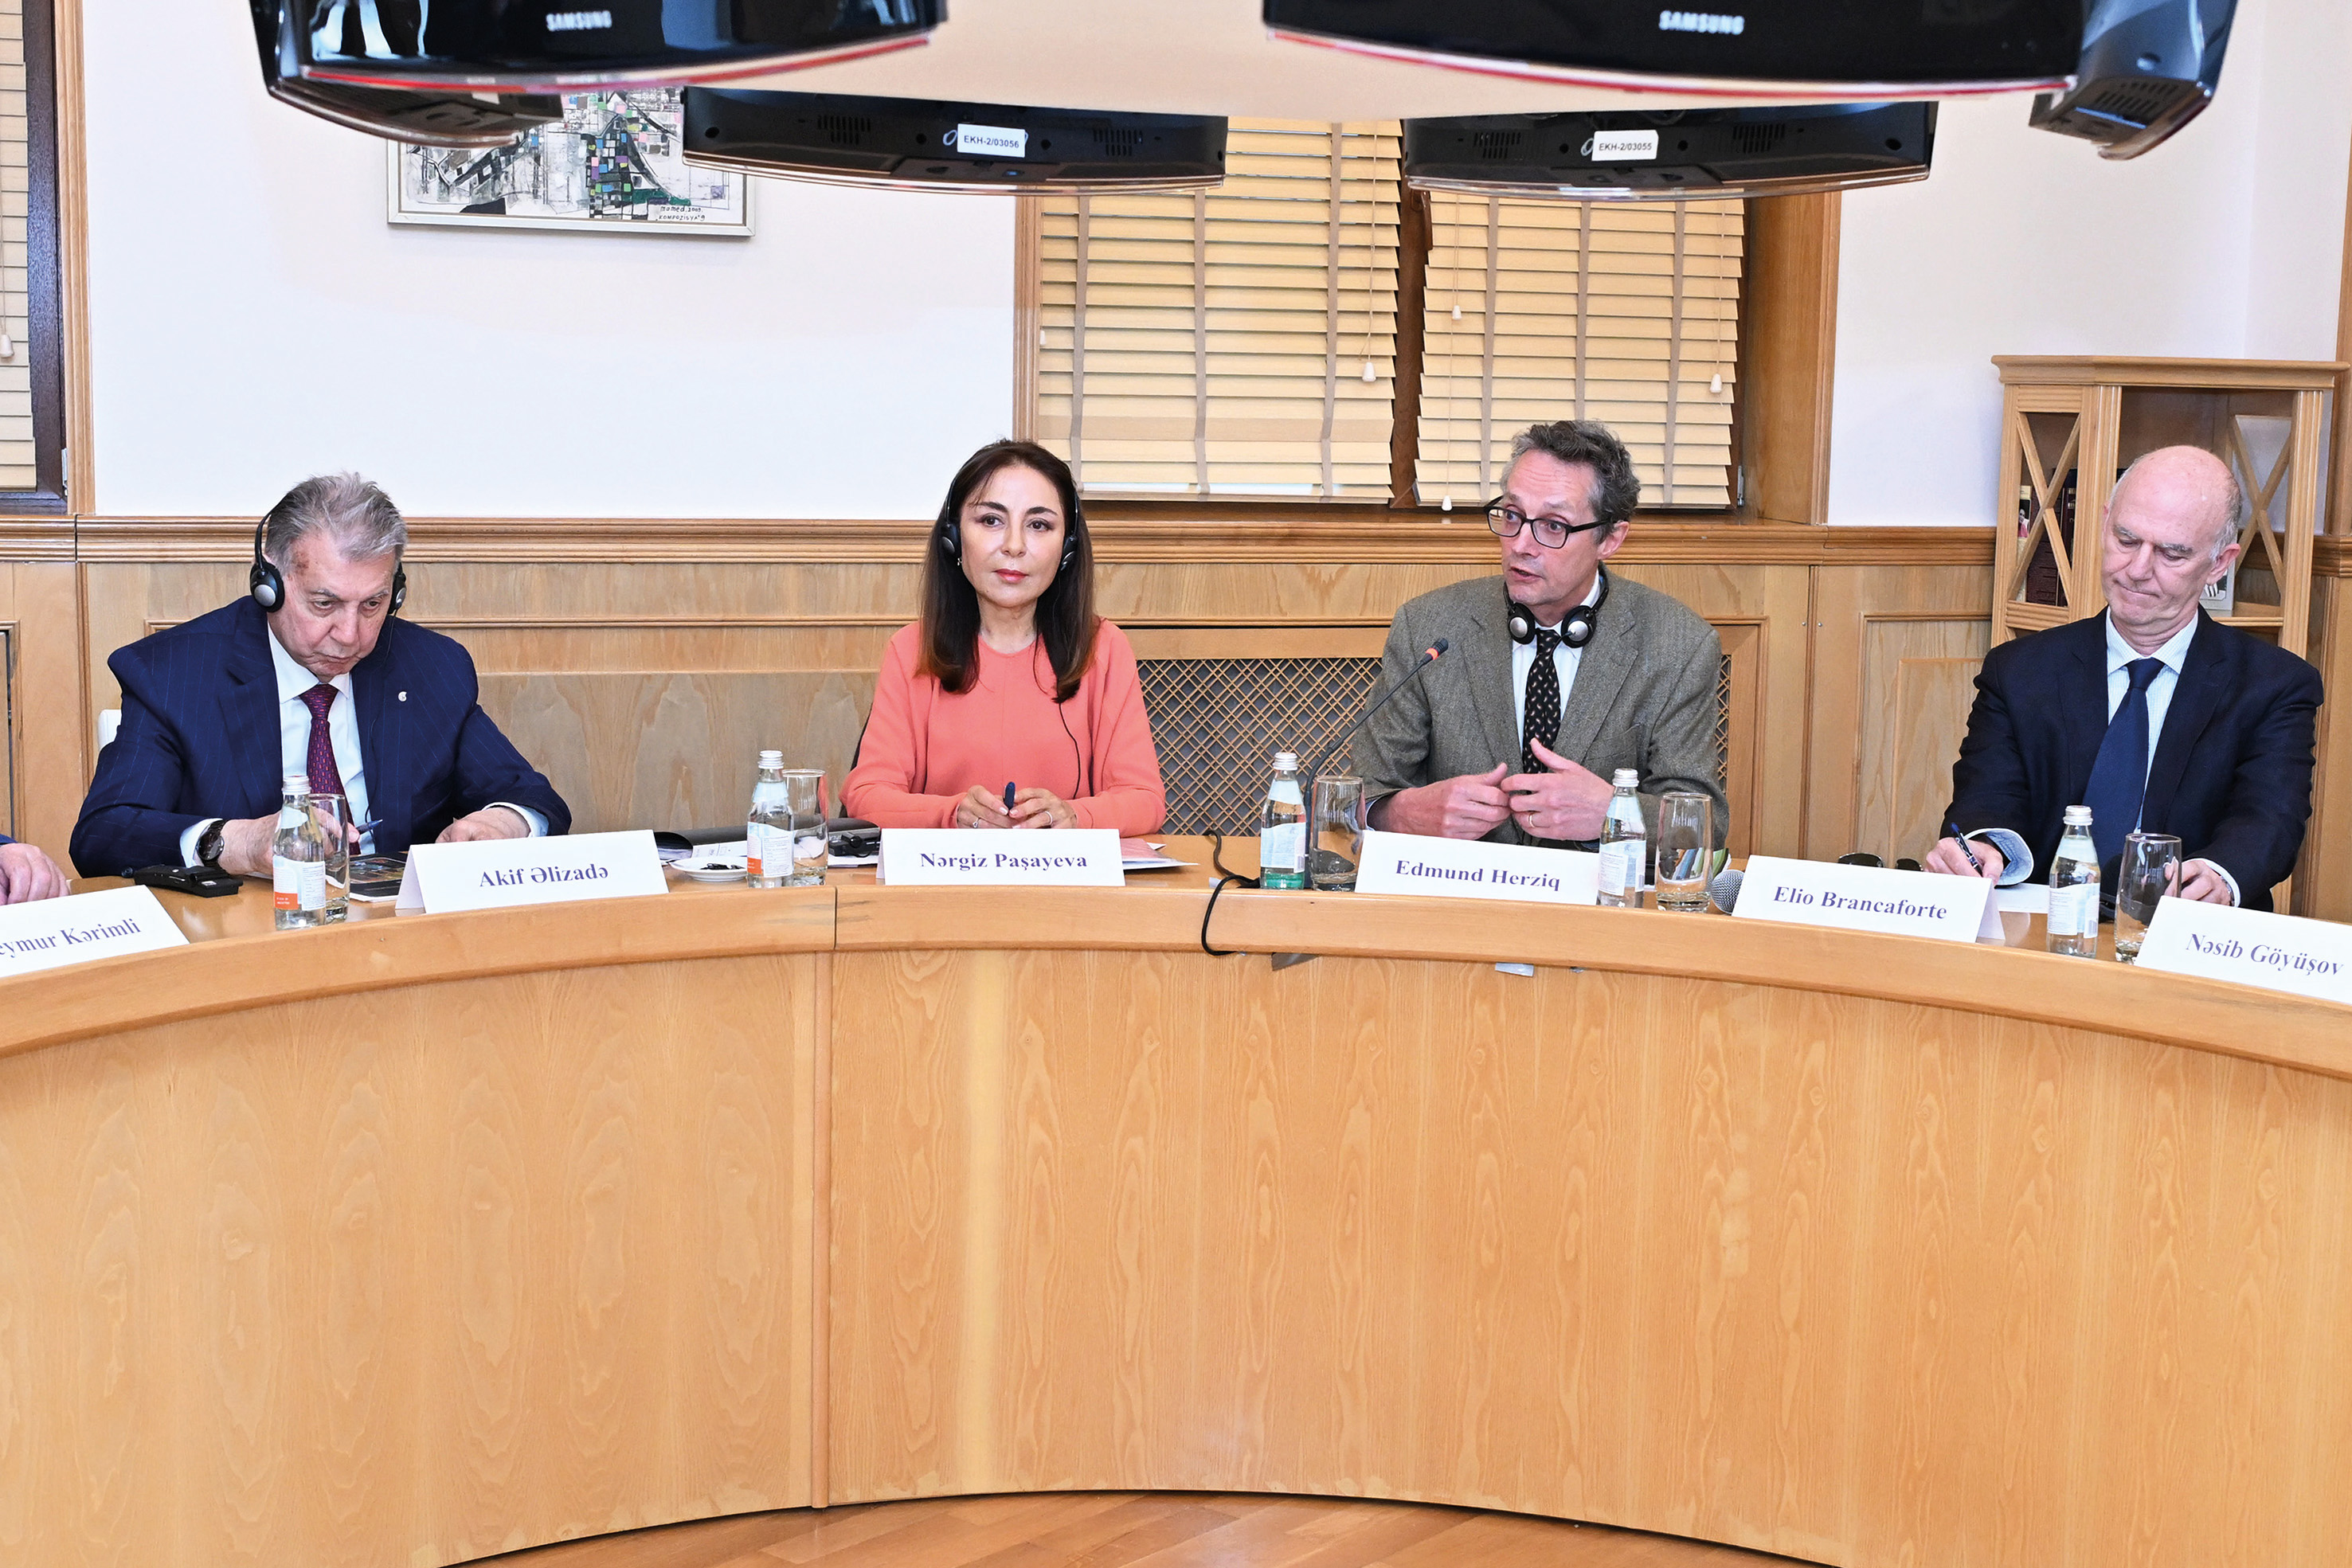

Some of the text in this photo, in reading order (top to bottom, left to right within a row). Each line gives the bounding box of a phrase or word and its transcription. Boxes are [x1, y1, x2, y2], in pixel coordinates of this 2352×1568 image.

[546, 10, 612, 32] SAMSUNG
[1658, 10, 1745, 36] SAMSUNG
[964, 135, 1019, 148] EKH-2/03056
[479, 863, 609, 887] Akif Əlizadə
[920, 853, 1088, 871] Nərgiz Paşayeva
[1395, 859, 1560, 892] Edmund Herziq
[1773, 886, 1947, 920] Elio Brancaforte
[59, 917, 142, 945] Kərimli
[2186, 933, 2344, 976] Nəsib Göyüşov
